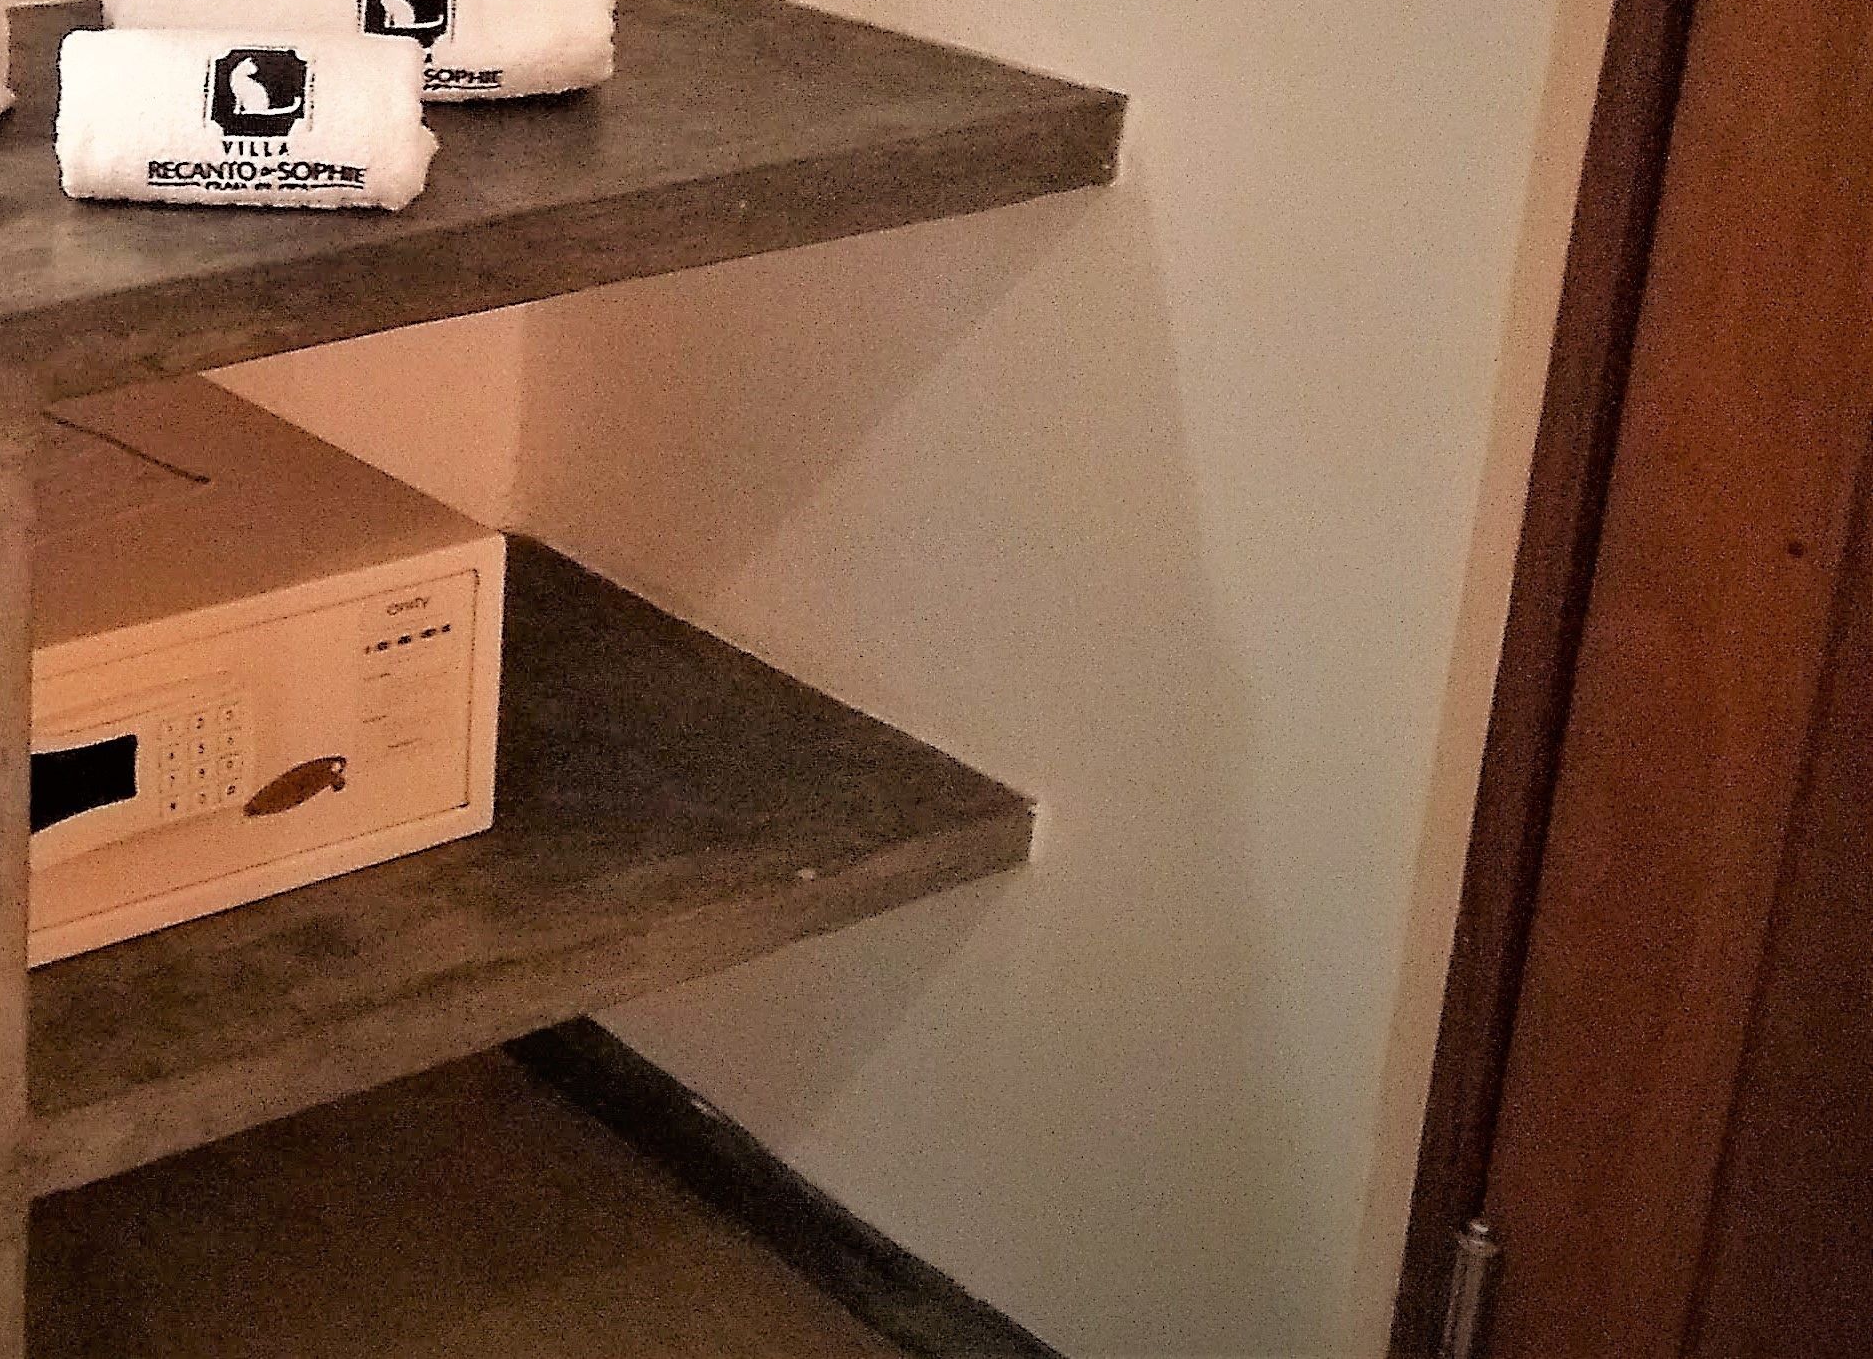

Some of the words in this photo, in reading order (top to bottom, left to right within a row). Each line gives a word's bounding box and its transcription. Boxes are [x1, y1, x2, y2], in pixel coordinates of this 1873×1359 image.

[221, 140, 290, 157] VILLA
[147, 160, 257, 181] RECANTO
[277, 161, 367, 184] SOPHIE
